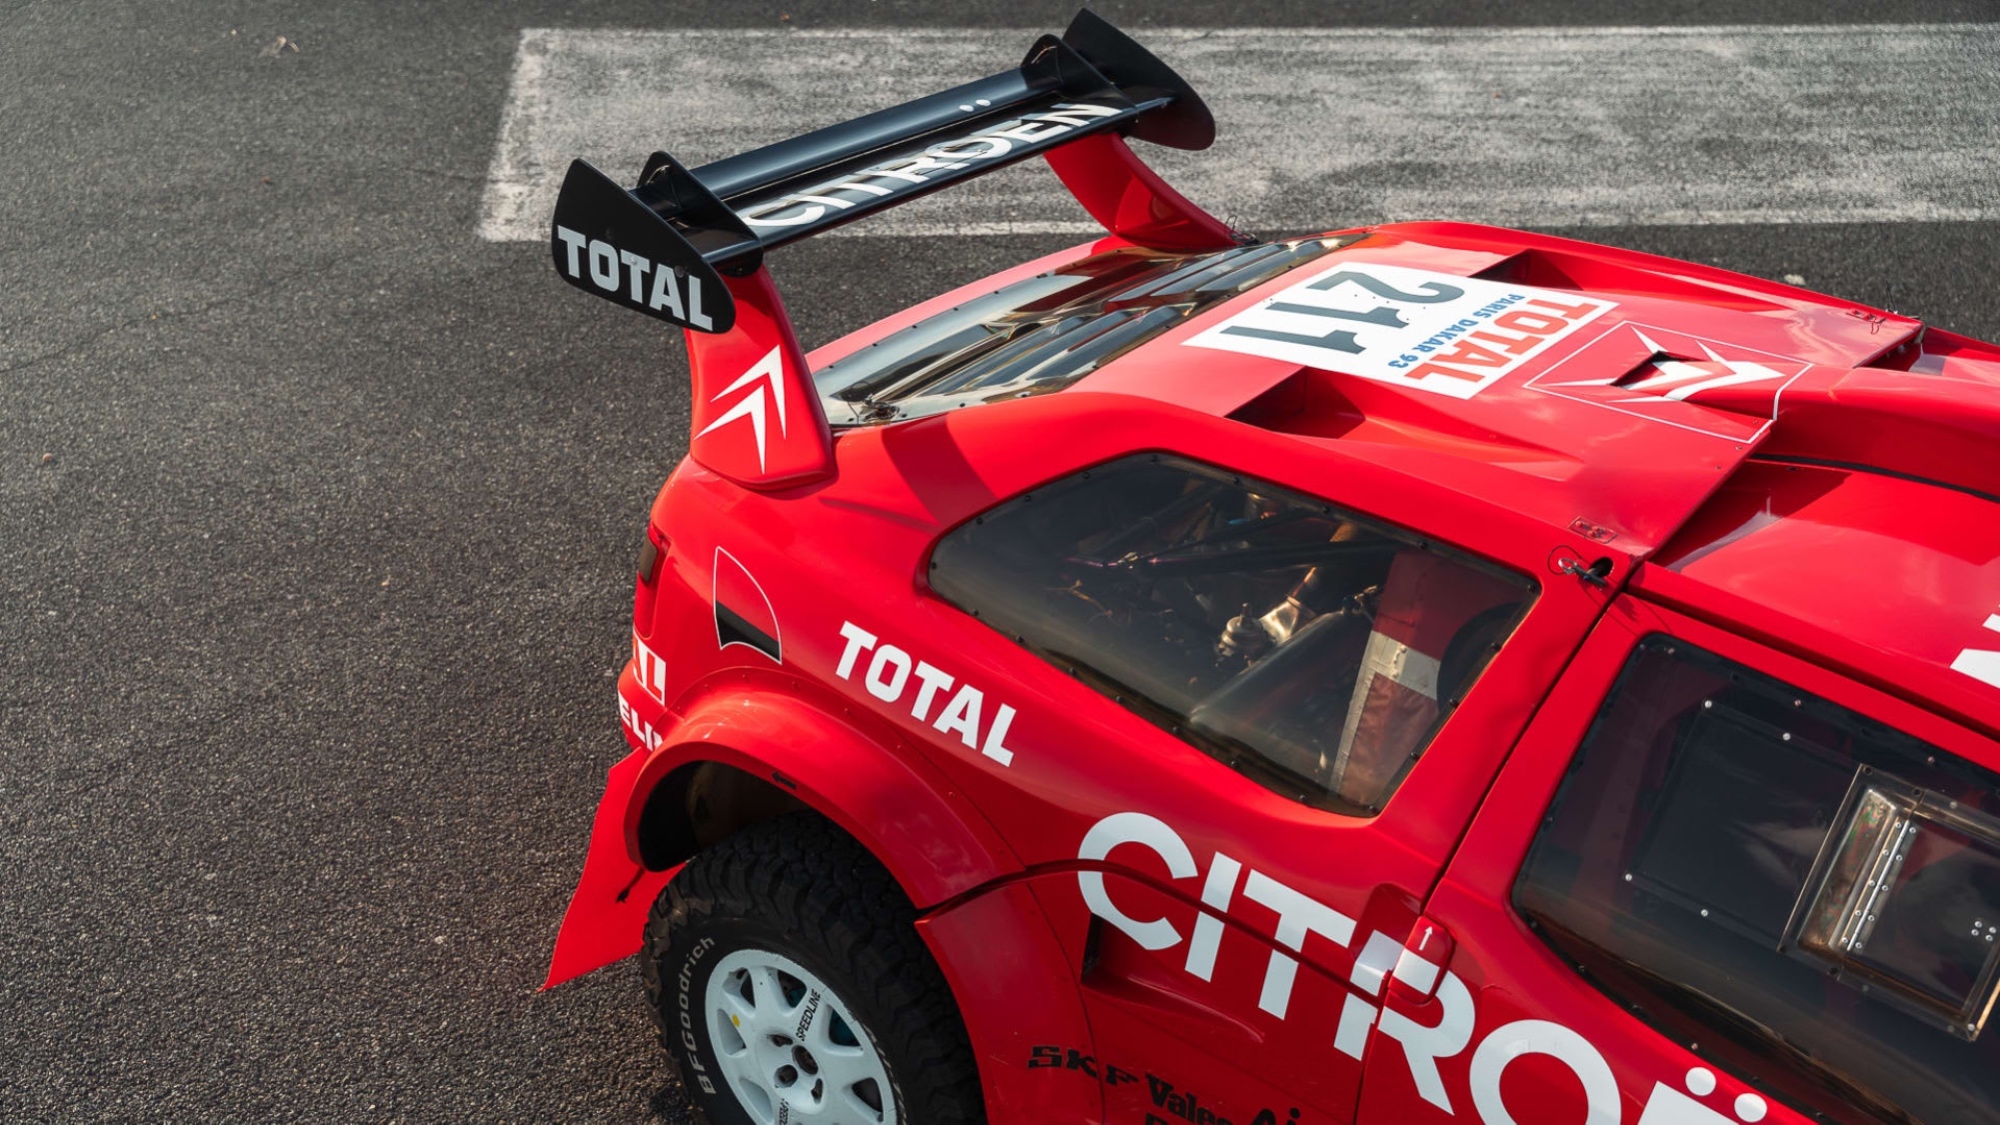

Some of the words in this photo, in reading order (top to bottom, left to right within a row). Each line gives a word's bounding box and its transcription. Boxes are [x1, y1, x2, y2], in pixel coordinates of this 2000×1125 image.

[557, 224, 713, 332] TOTAL
[1219, 270, 1466, 355] 211
[1473, 294, 1526, 318] PARIS
[1388, 353, 1419, 369] 93
[1404, 298, 1601, 383] TOTAL
[1412, 318, 1479, 353] DAKAR
[836, 620, 1016, 767] TOTAL
[796, 988, 821, 1042] SPEEDLINE
[1027, 1045, 1139, 1087] SKF
